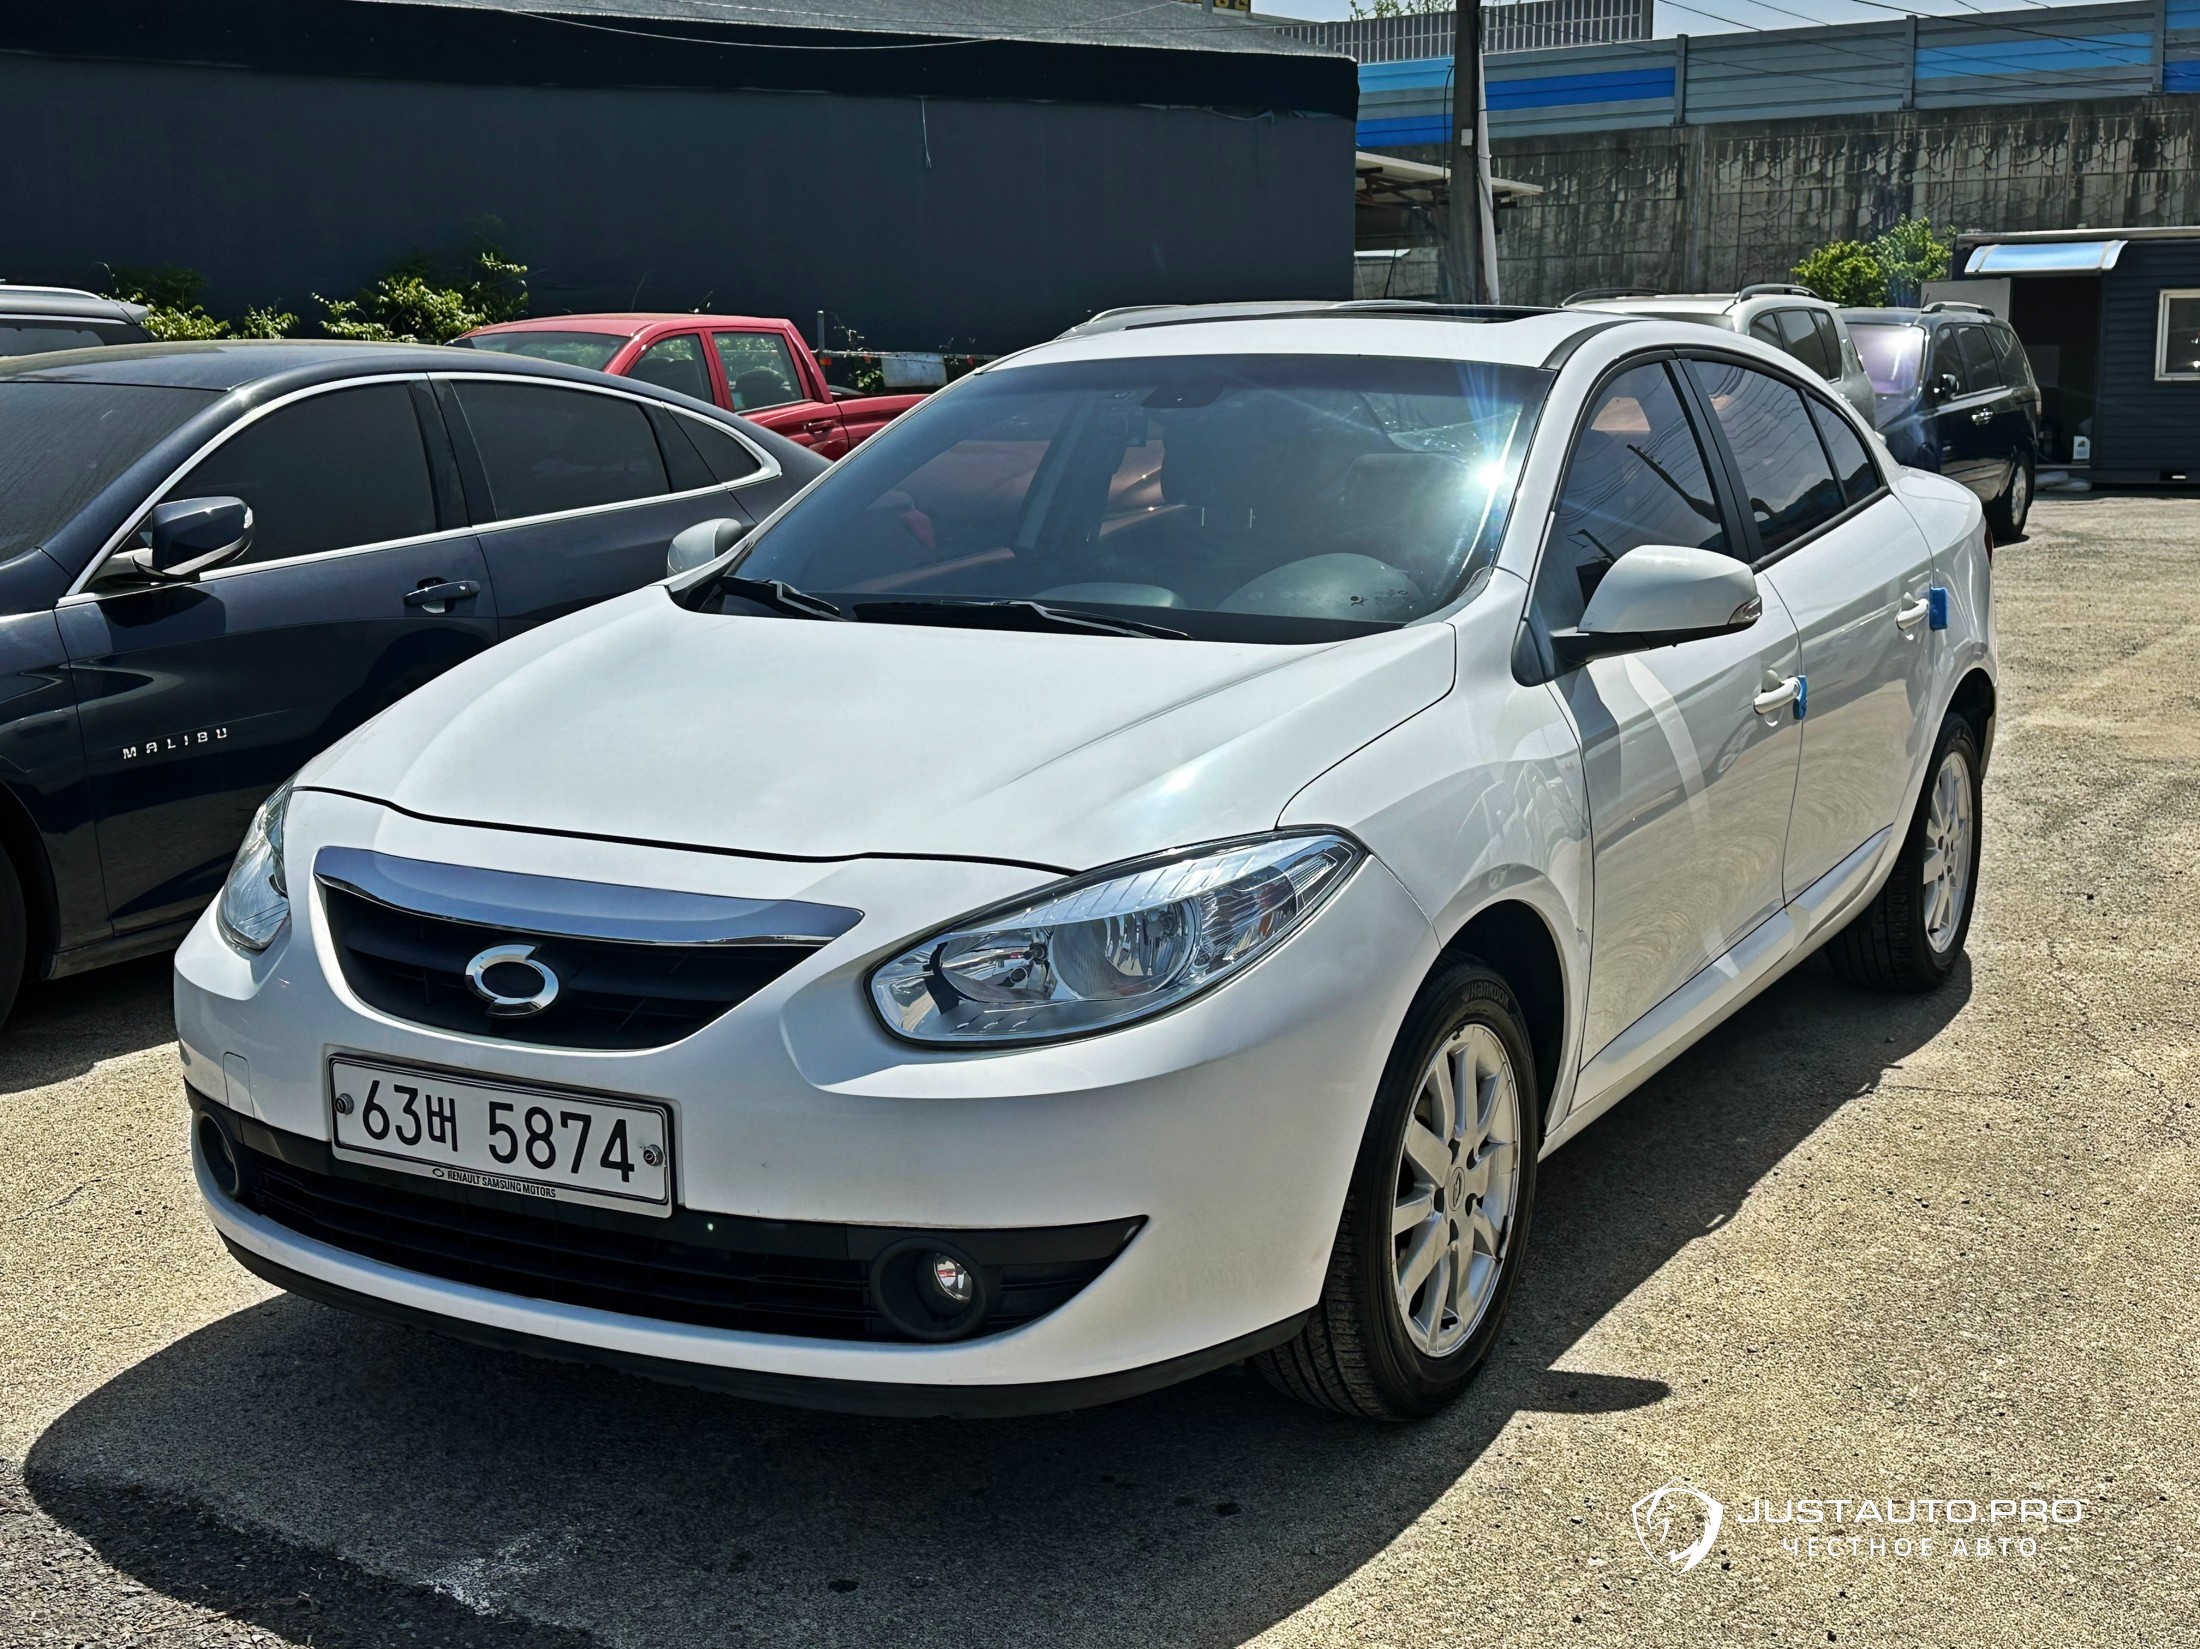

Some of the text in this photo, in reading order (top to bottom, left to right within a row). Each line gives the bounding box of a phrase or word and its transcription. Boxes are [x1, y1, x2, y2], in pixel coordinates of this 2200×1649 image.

[122, 727, 228, 760] MALIBU
[362, 1080, 635, 1183] 63버 5874
[447, 1170, 556, 1198] RENAULT SAMSUNG MOTORS
